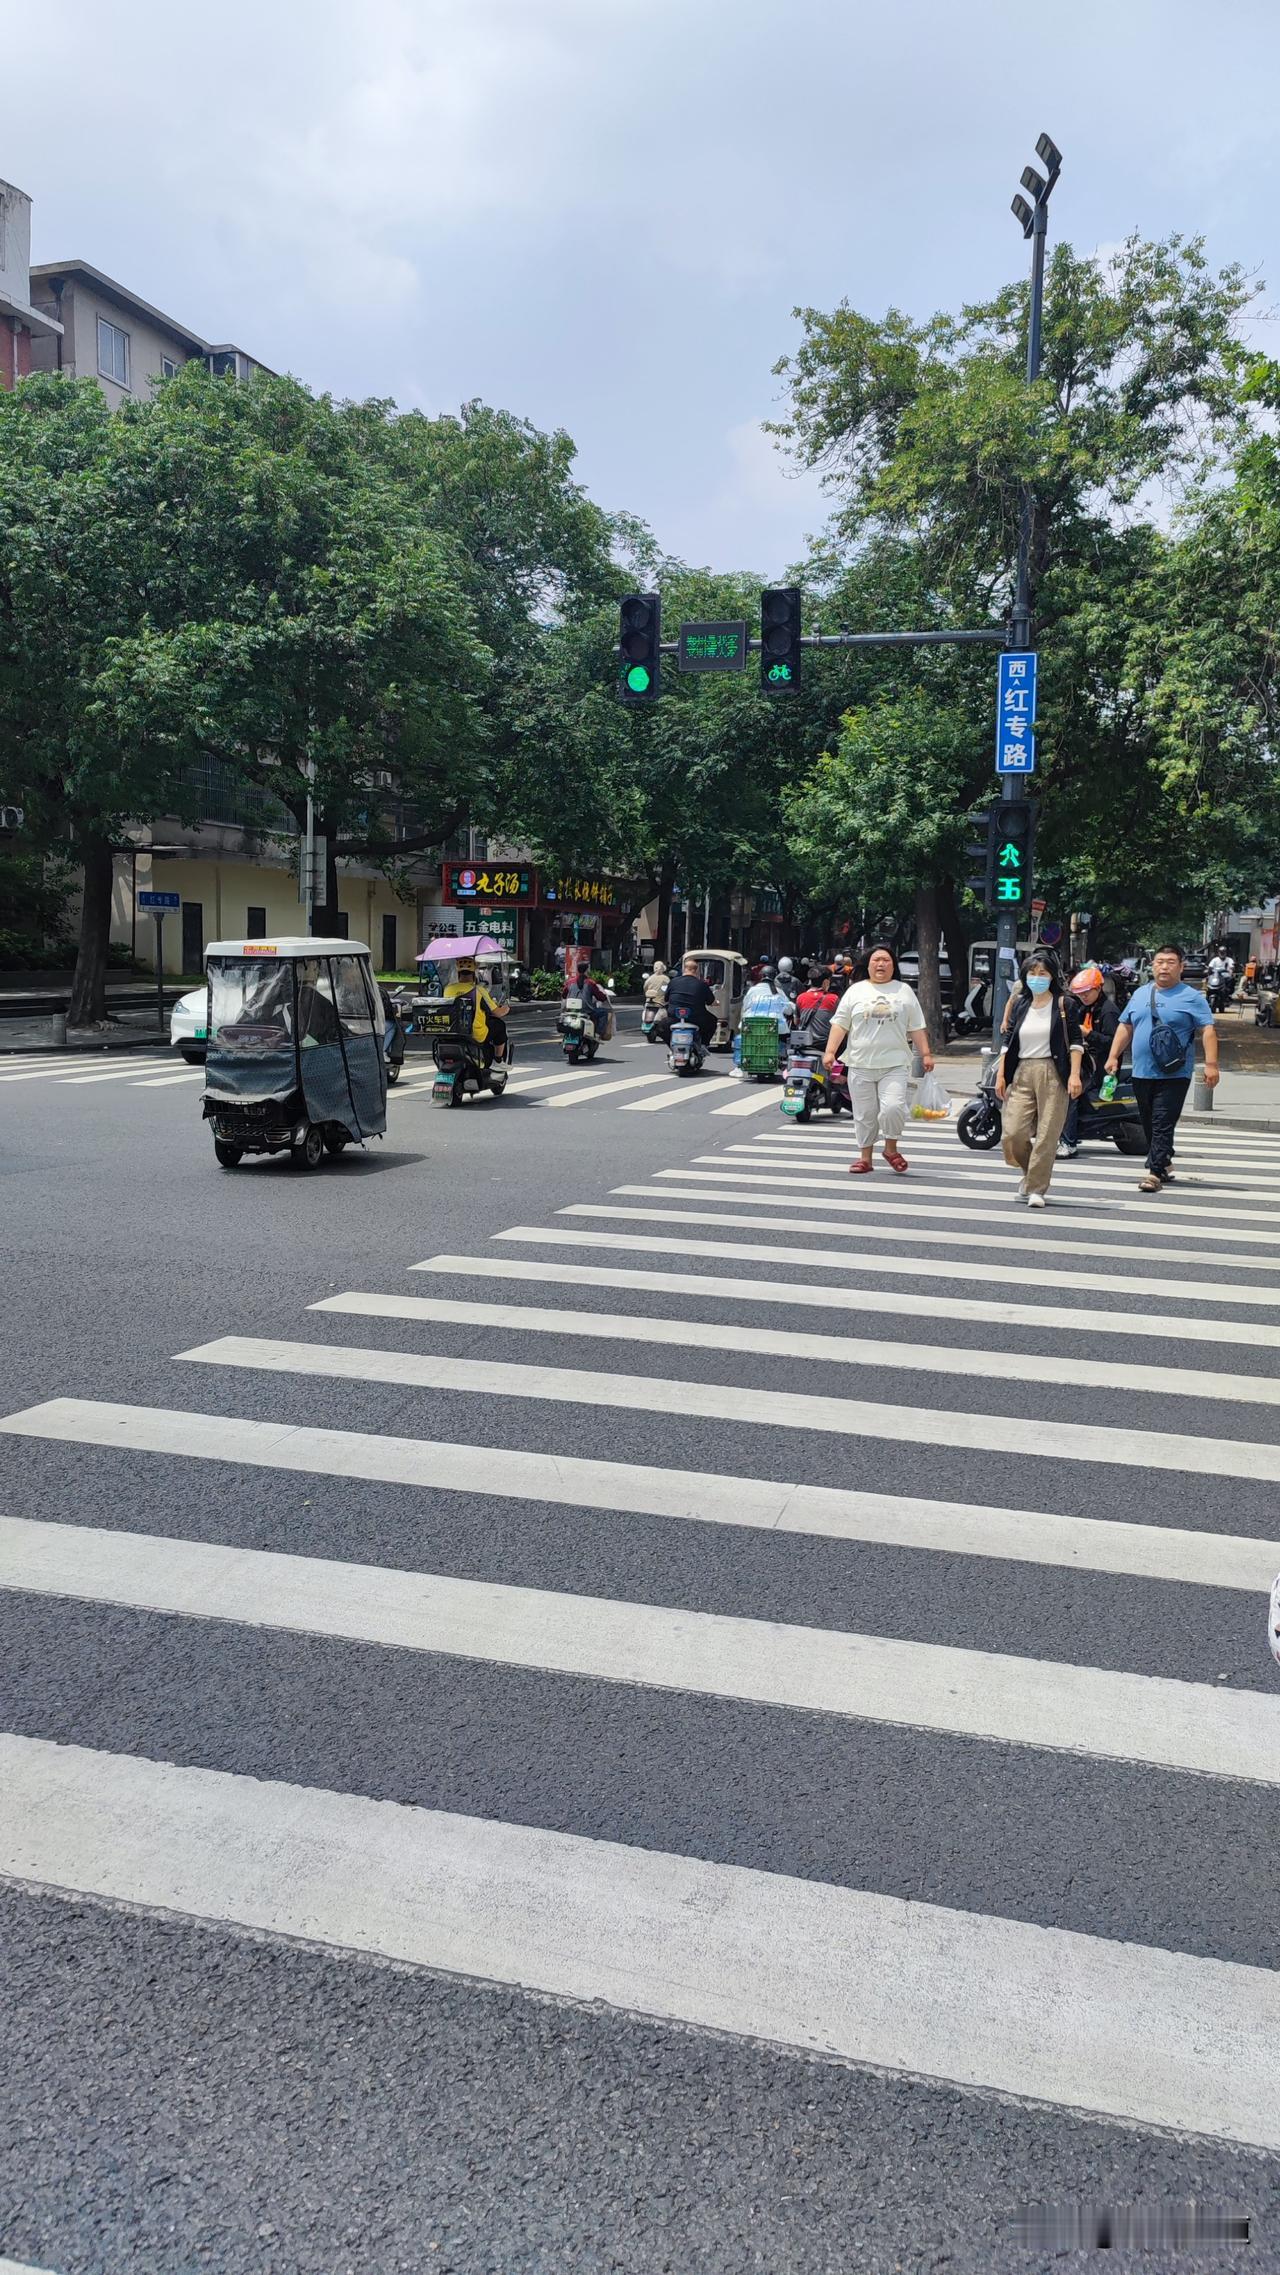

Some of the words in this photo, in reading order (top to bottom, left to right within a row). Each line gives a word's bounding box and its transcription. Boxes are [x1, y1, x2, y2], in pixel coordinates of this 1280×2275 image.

[1008, 660, 1027, 678] 西
[1003, 688, 1029, 767] 红专路
[476, 872, 520, 897] 丸子汤
[464, 920, 515, 934] 五金电料
